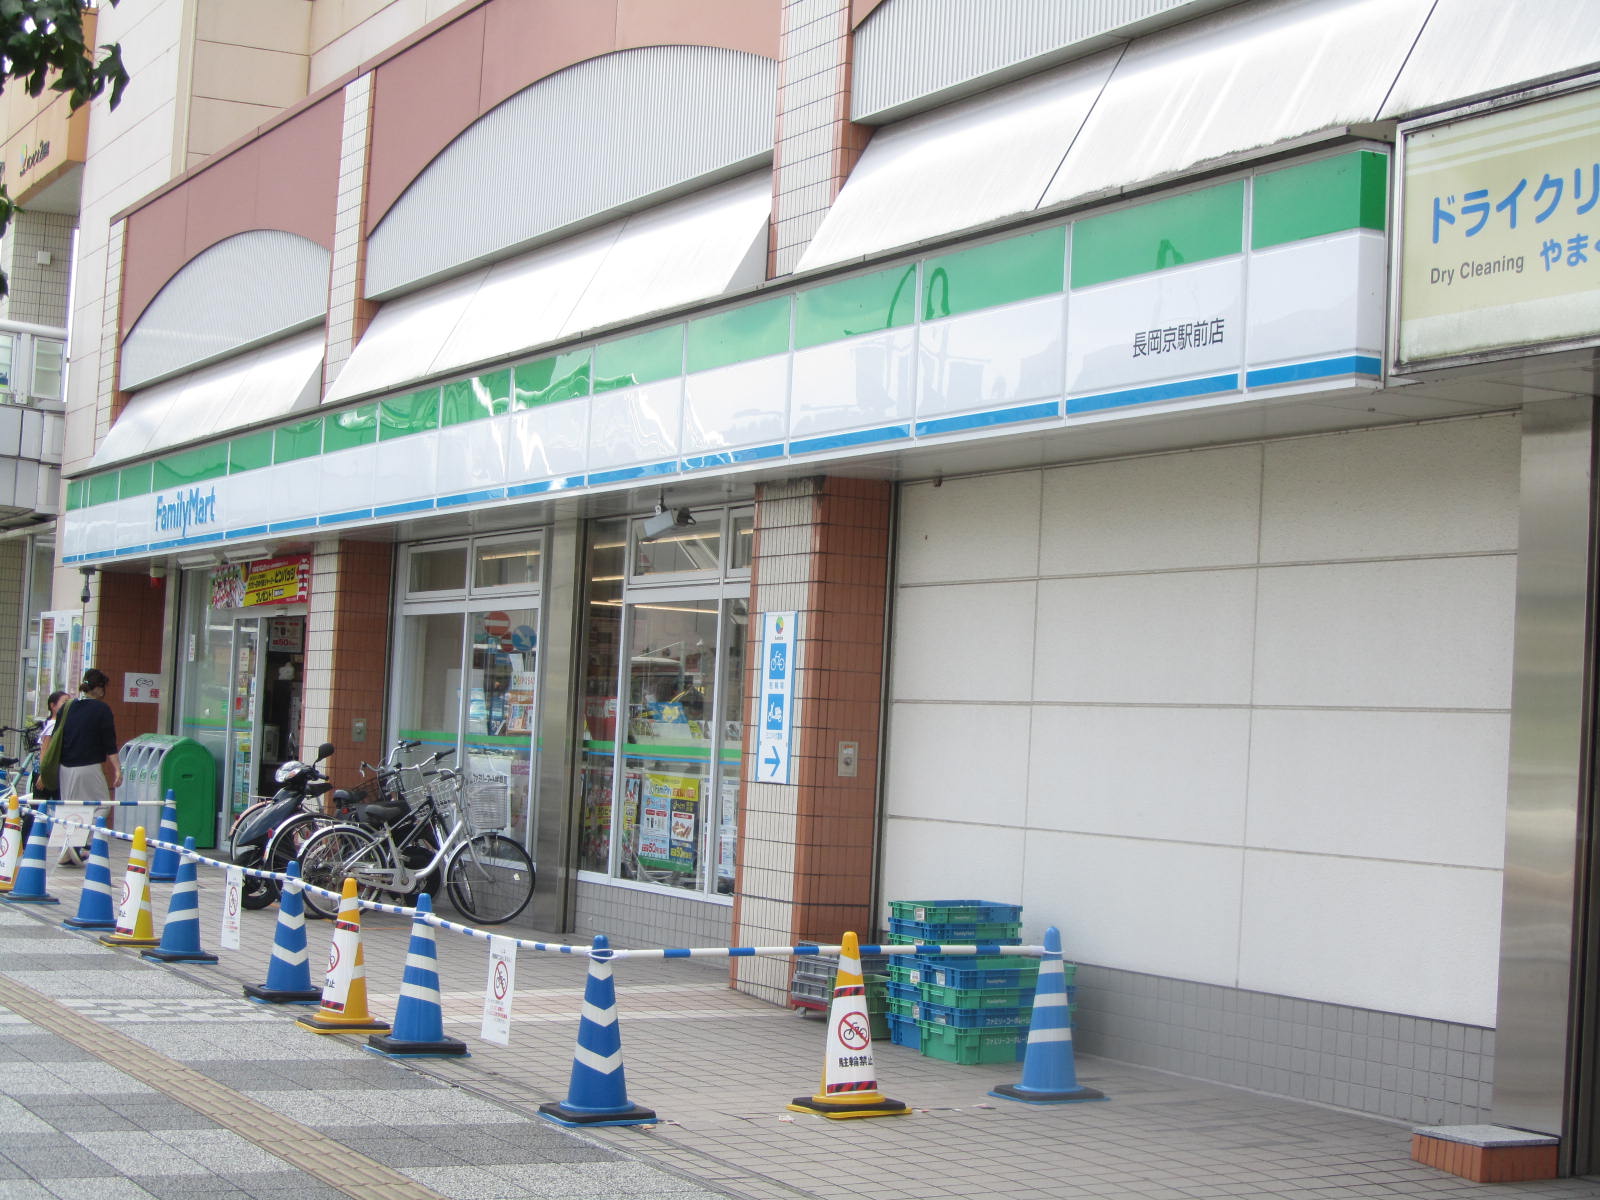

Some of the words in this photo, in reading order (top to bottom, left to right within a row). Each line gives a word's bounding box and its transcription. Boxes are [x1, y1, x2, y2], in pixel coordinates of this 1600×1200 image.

[1430, 267, 1455, 286] Dry
[1459, 255, 1525, 280] Cleaning
[1539, 233, 1600, 272] やま
[1132, 317, 1225, 358] 長岡京駅前店
[155, 486, 216, 537] FamilyMart
[838, 1055, 873, 1068] 駐輪禁止
